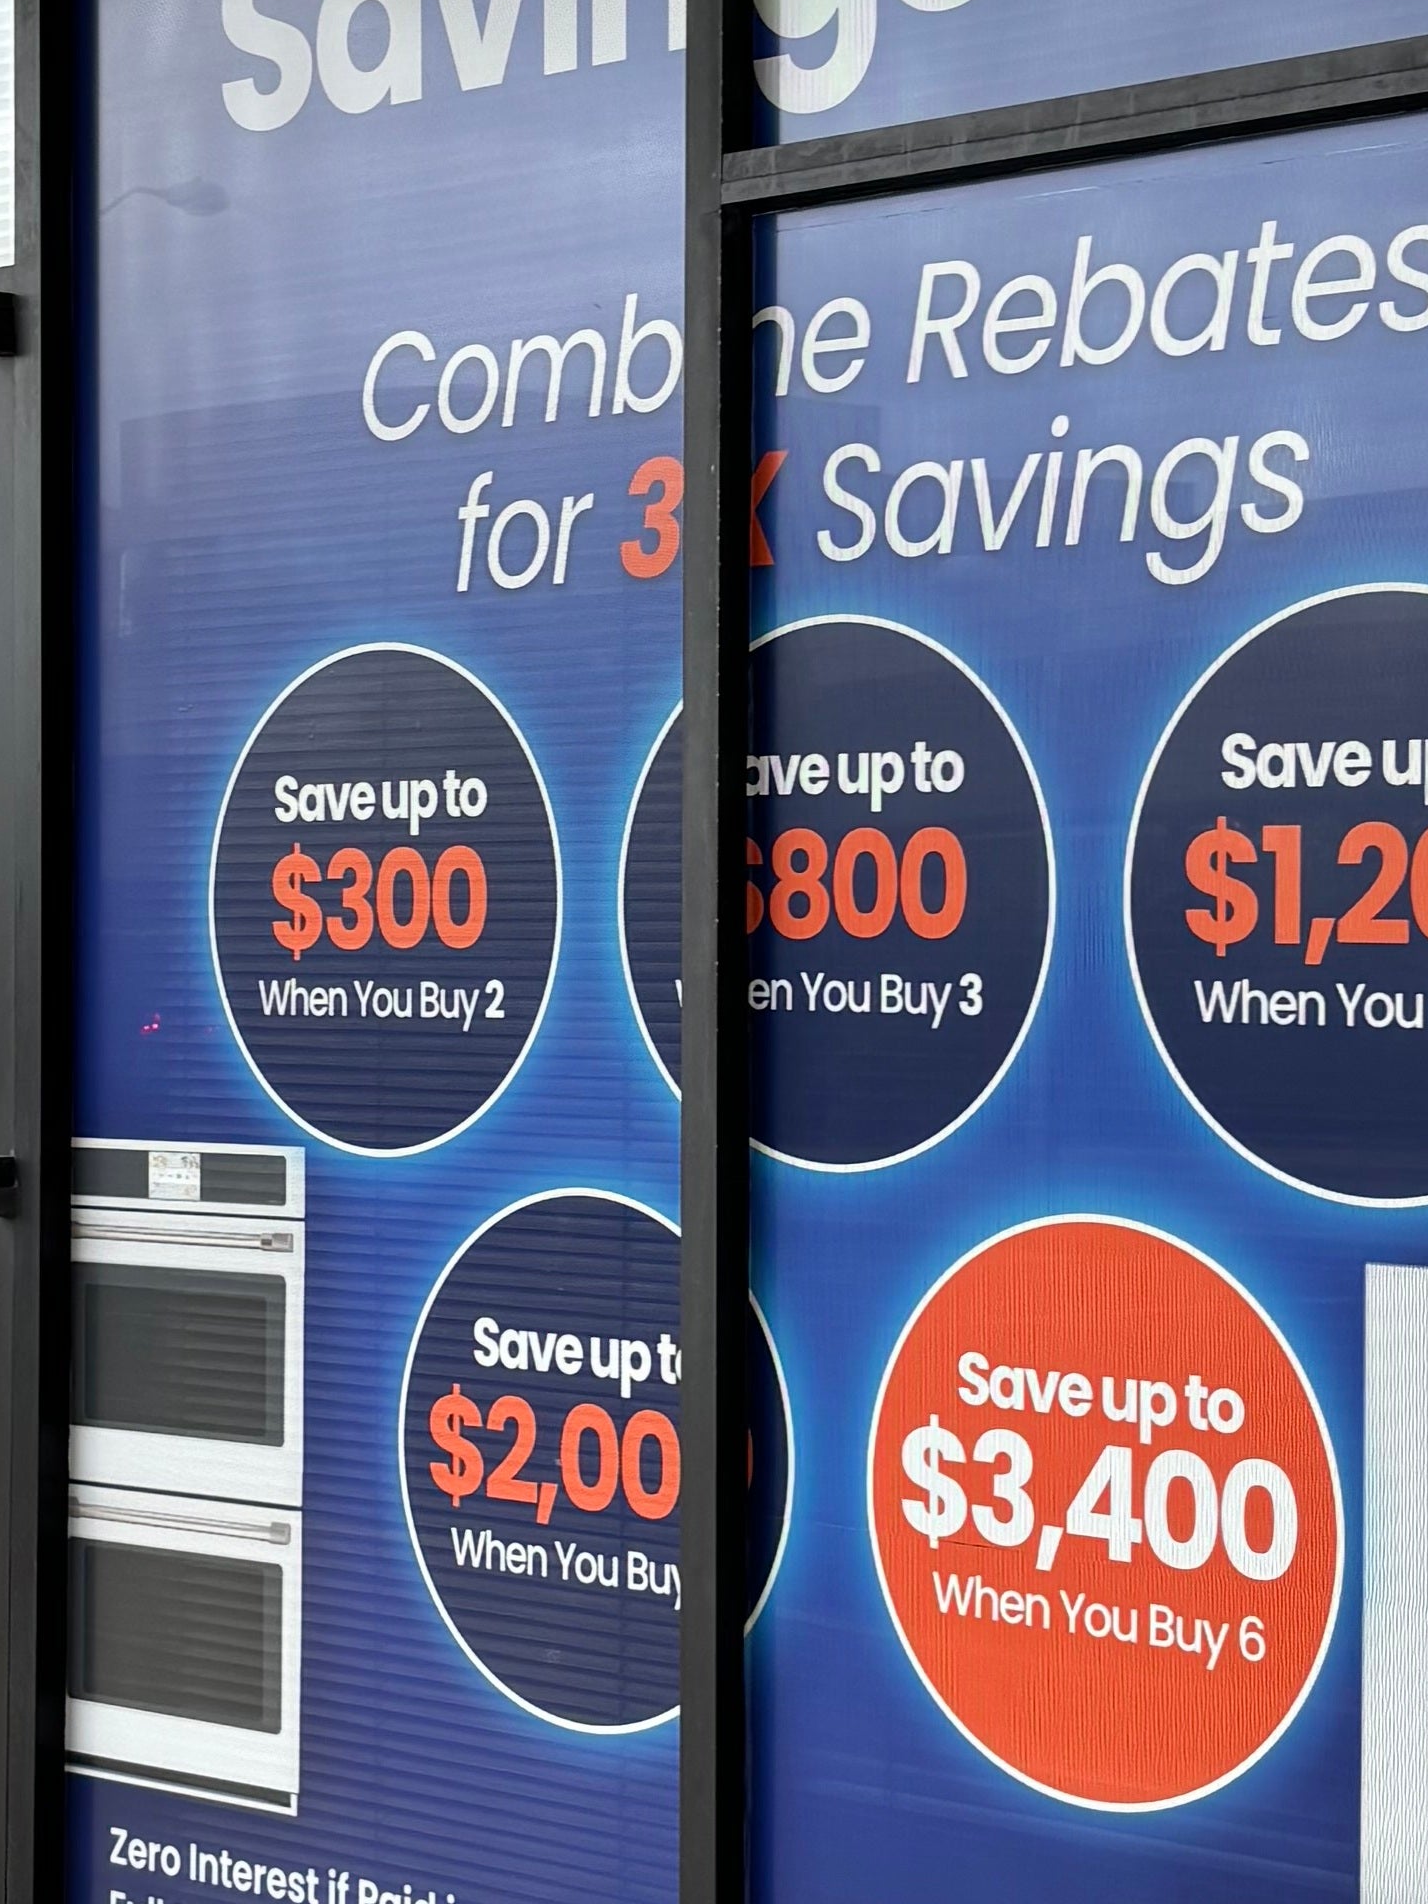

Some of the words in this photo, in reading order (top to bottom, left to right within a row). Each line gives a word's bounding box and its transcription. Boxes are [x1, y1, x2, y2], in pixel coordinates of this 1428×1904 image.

[362, 293, 871, 442] Combne
[457, 471, 593, 594] for
[815, 415, 1310, 587] Savings
[746, 752, 831, 797] ave
[837, 751, 905, 813] up
[910, 741, 965, 794] to
[1220, 732, 1372, 790] Save
[274, 774, 376, 823] Save
[381, 779, 439, 836] up
[442, 769, 488, 818] to
[272, 841, 488, 961] $300
[258, 978, 348, 1017] When
[353, 980, 413, 1018] You
[420, 981, 480, 1032] Buy
[485, 979, 505, 1019] 2
[800, 972, 870, 1013] You
[880, 973, 952, 1029] Buy
[958, 972, 984, 1016] 3
[1194, 978, 1326, 1027] When
[1335, 983, 1424, 1029] You
[473, 1316, 584, 1376] Save
[590, 1336, 652, 1399] up
[657, 1333, 682, 1385] t
[957, 1351, 1094, 1418] Save
[1102, 1374, 1178, 1446] up
[1184, 1374, 1246, 1434] to
[429, 1382, 753, 1526] $2,00
[900, 1413, 1299, 1582] $3,400
[450, 1526, 548, 1578] When
[554, 1540, 619, 1588] You
[932, 1570, 1050, 1630] When
[1059, 1589, 1137, 1644] You
[1148, 1602, 1230, 1672] Buy
[1238, 1615, 1267, 1663] 6
[109, 1827, 182, 1877] Zero
